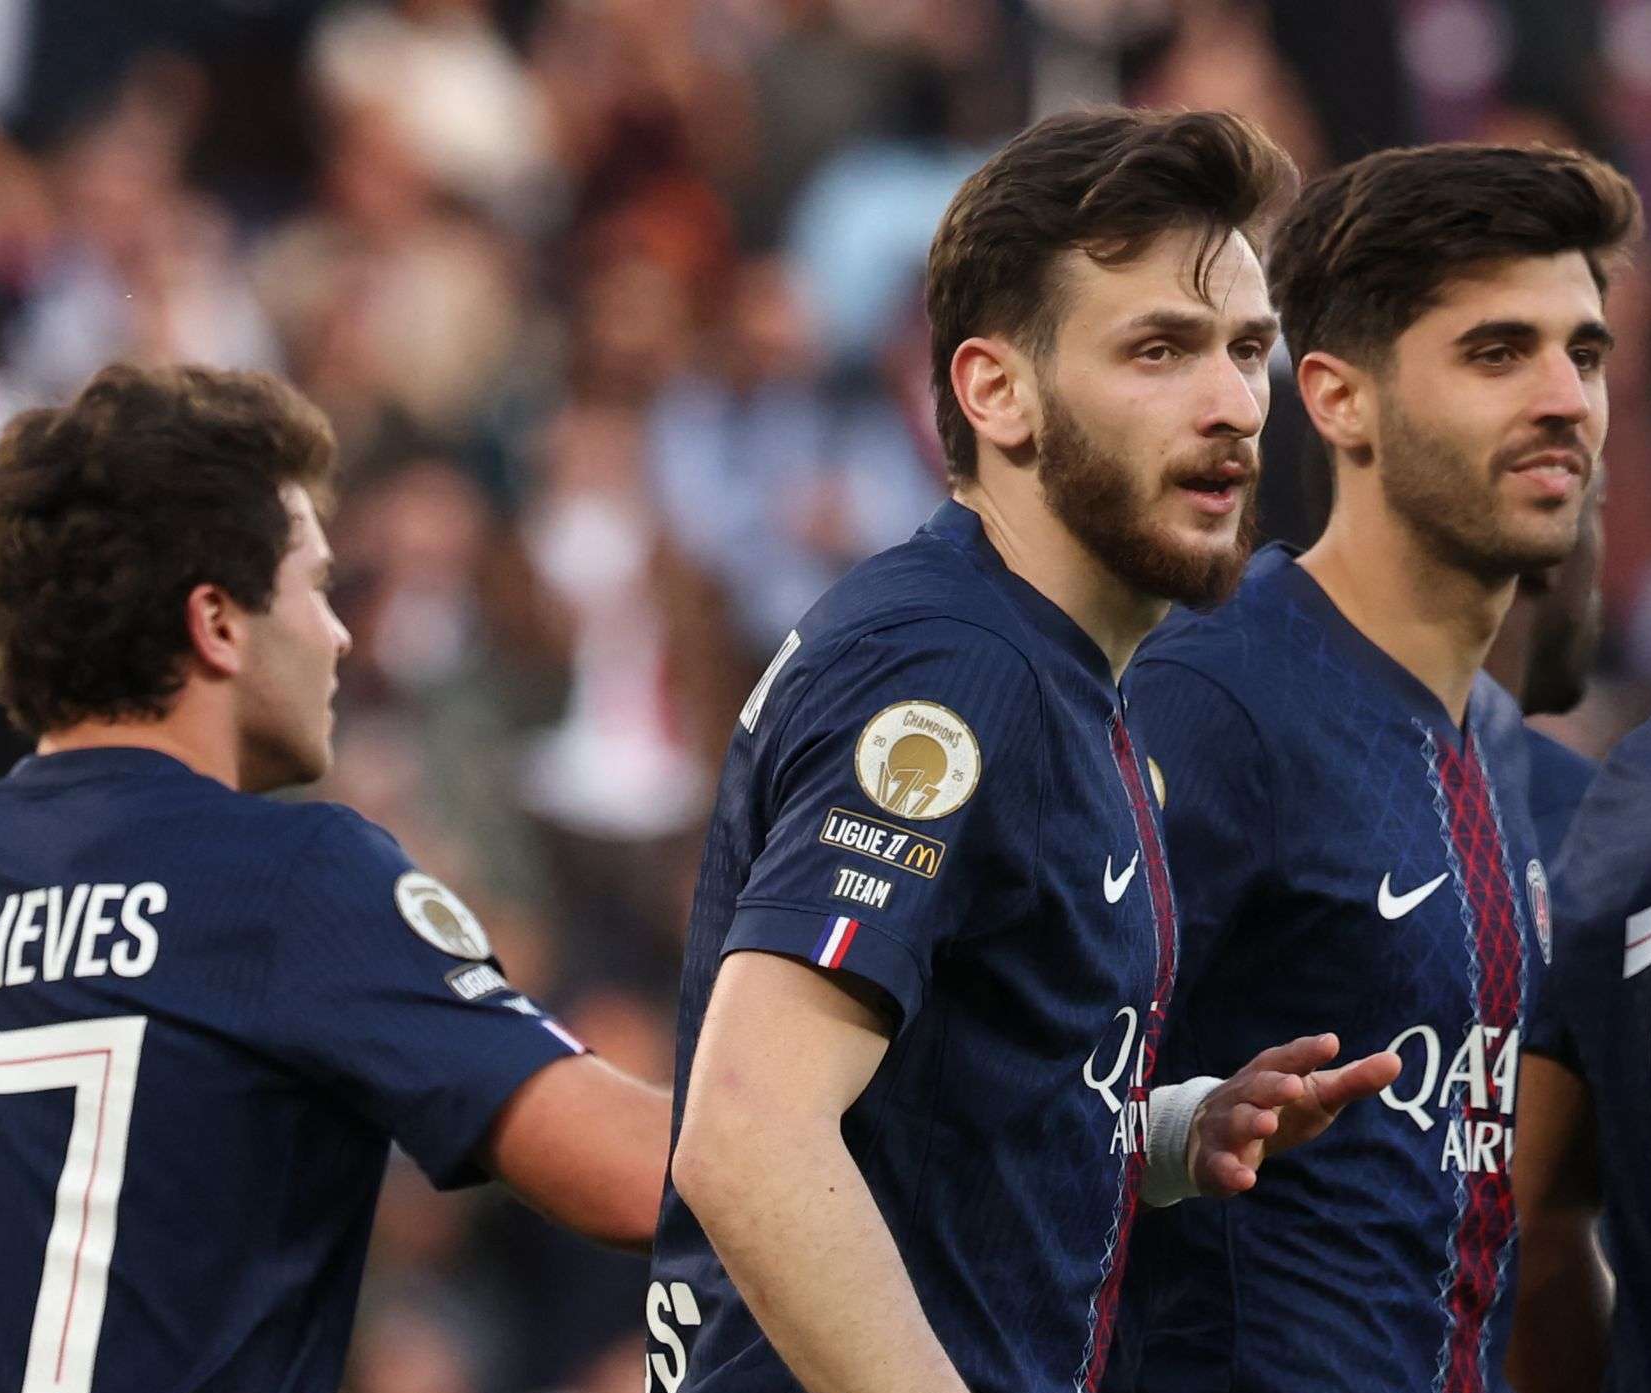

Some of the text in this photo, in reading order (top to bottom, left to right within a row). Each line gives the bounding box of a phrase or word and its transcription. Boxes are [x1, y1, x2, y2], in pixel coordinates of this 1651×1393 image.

[873, 735, 886, 748] 20
[903, 709, 963, 749] CHAMPIONS
[824, 816, 887, 856] LIGUE
